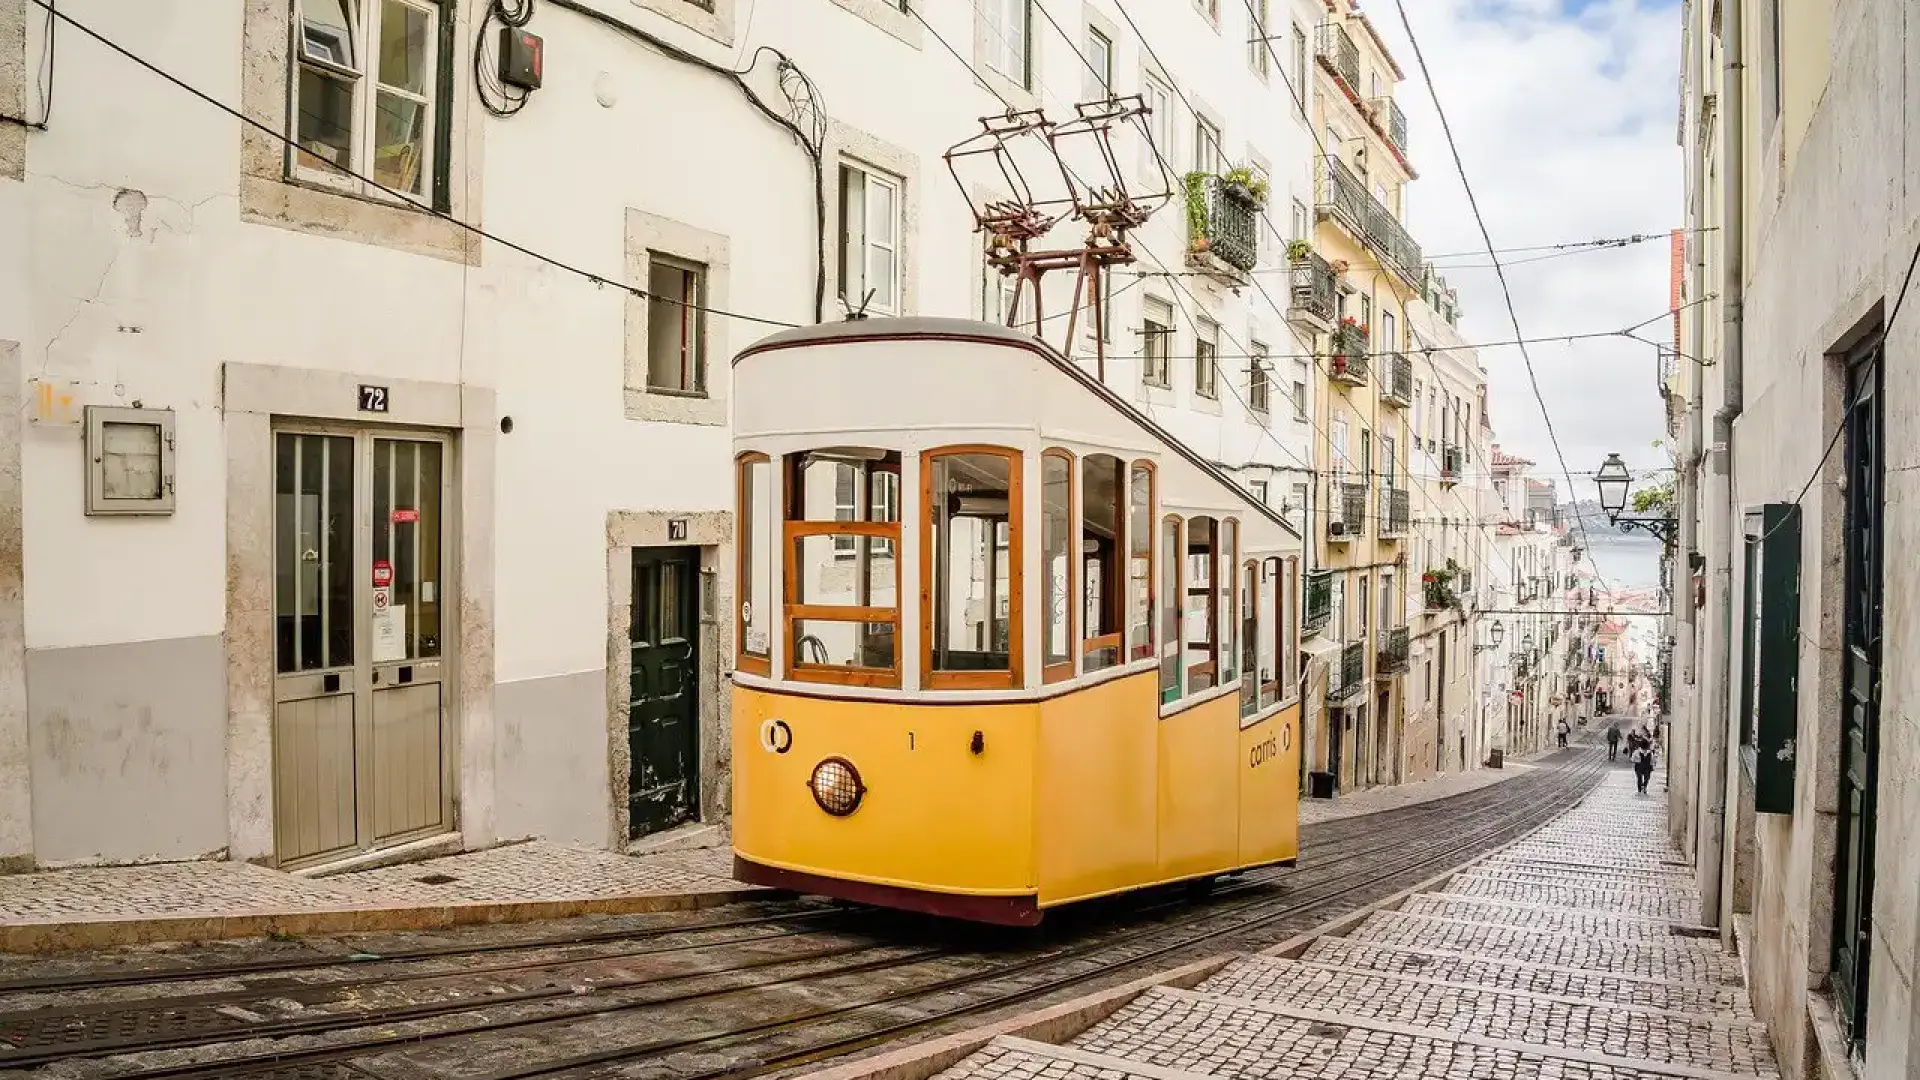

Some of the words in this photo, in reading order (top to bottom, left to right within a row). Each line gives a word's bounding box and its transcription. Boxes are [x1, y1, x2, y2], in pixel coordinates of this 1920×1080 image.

[364, 387, 385, 410] 72
[672, 521, 685, 539] 70
[908, 731, 915, 751] 1
[1250, 730, 1276, 768] carris
